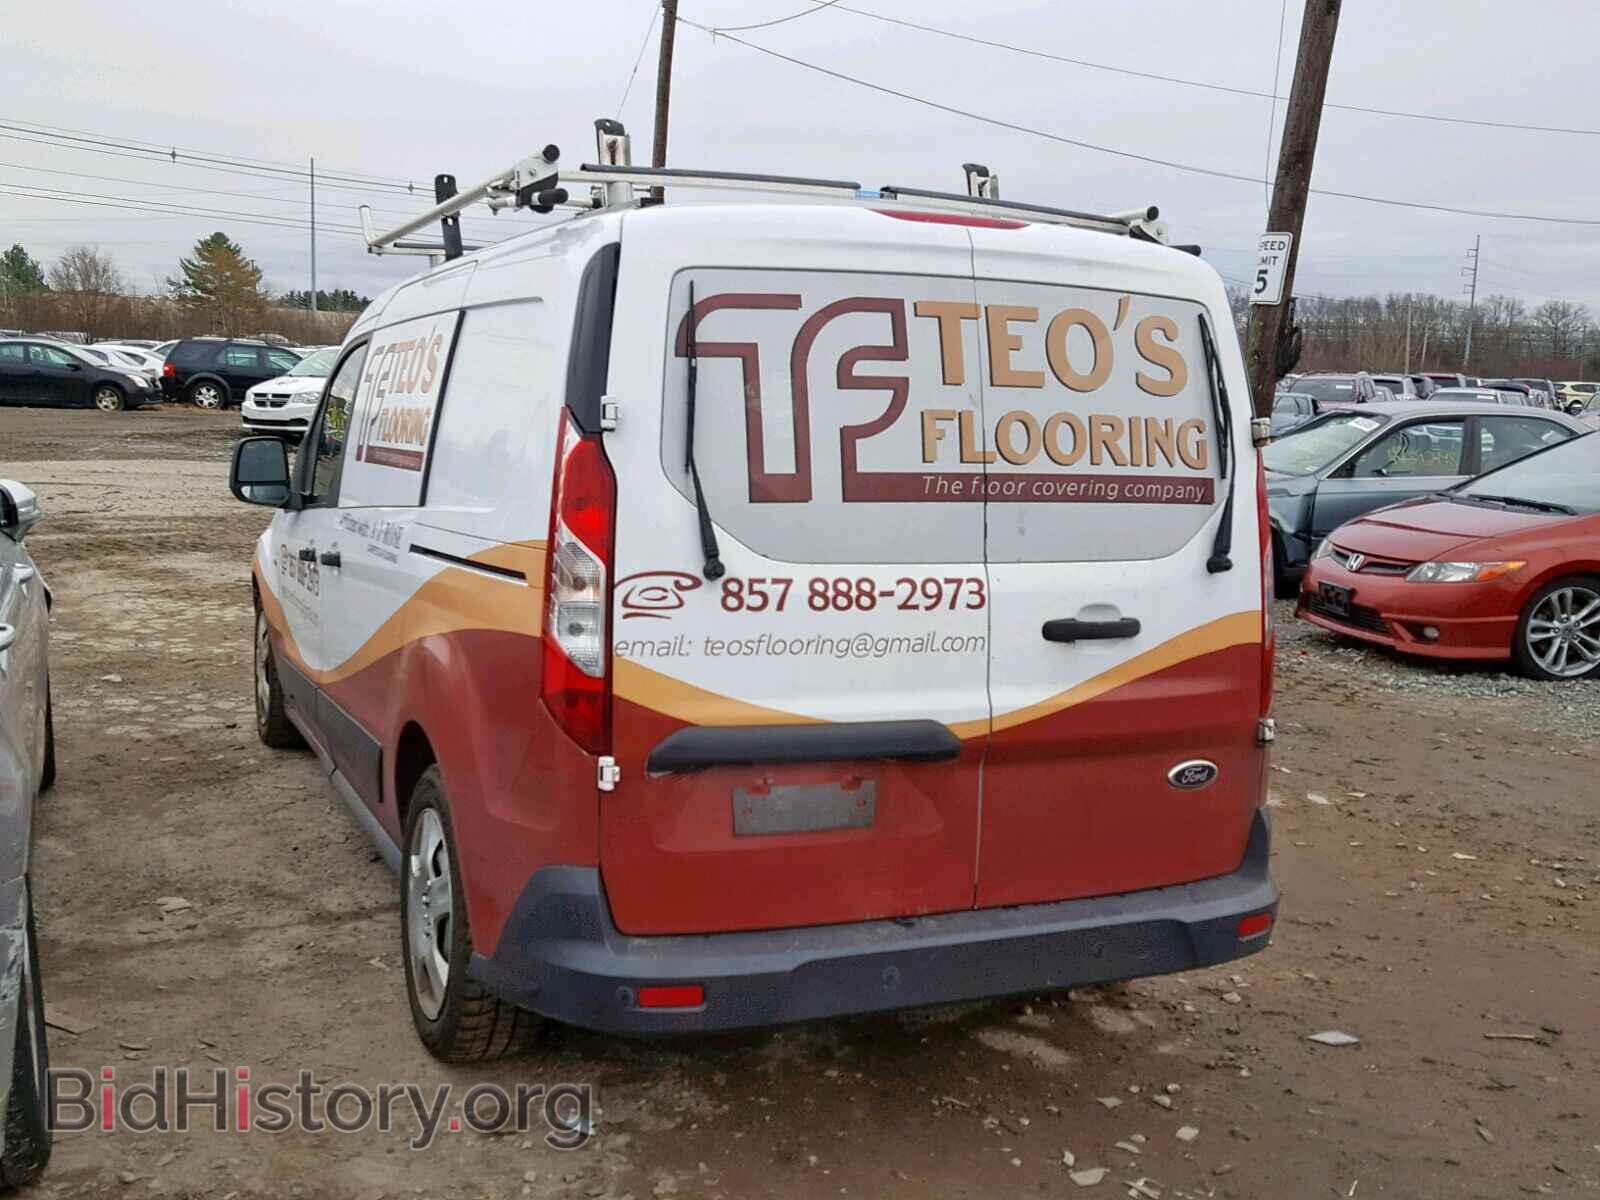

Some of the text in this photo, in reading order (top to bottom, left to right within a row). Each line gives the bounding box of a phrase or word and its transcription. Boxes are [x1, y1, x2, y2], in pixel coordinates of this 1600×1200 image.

[1254, 269, 1268, 294] 5
[914, 295, 1188, 398] TEO'S
[921, 409, 1208, 471] FLOORING
[922, 475, 963, 496] The
[1032, 479, 1125, 499] covering
[1125, 482, 1206, 502] company
[721, 576, 987, 613] 857 888-2973
[615, 631, 985, 658] email: teosflooring@gmail.com
[1182, 767, 1209, 784] Ford
